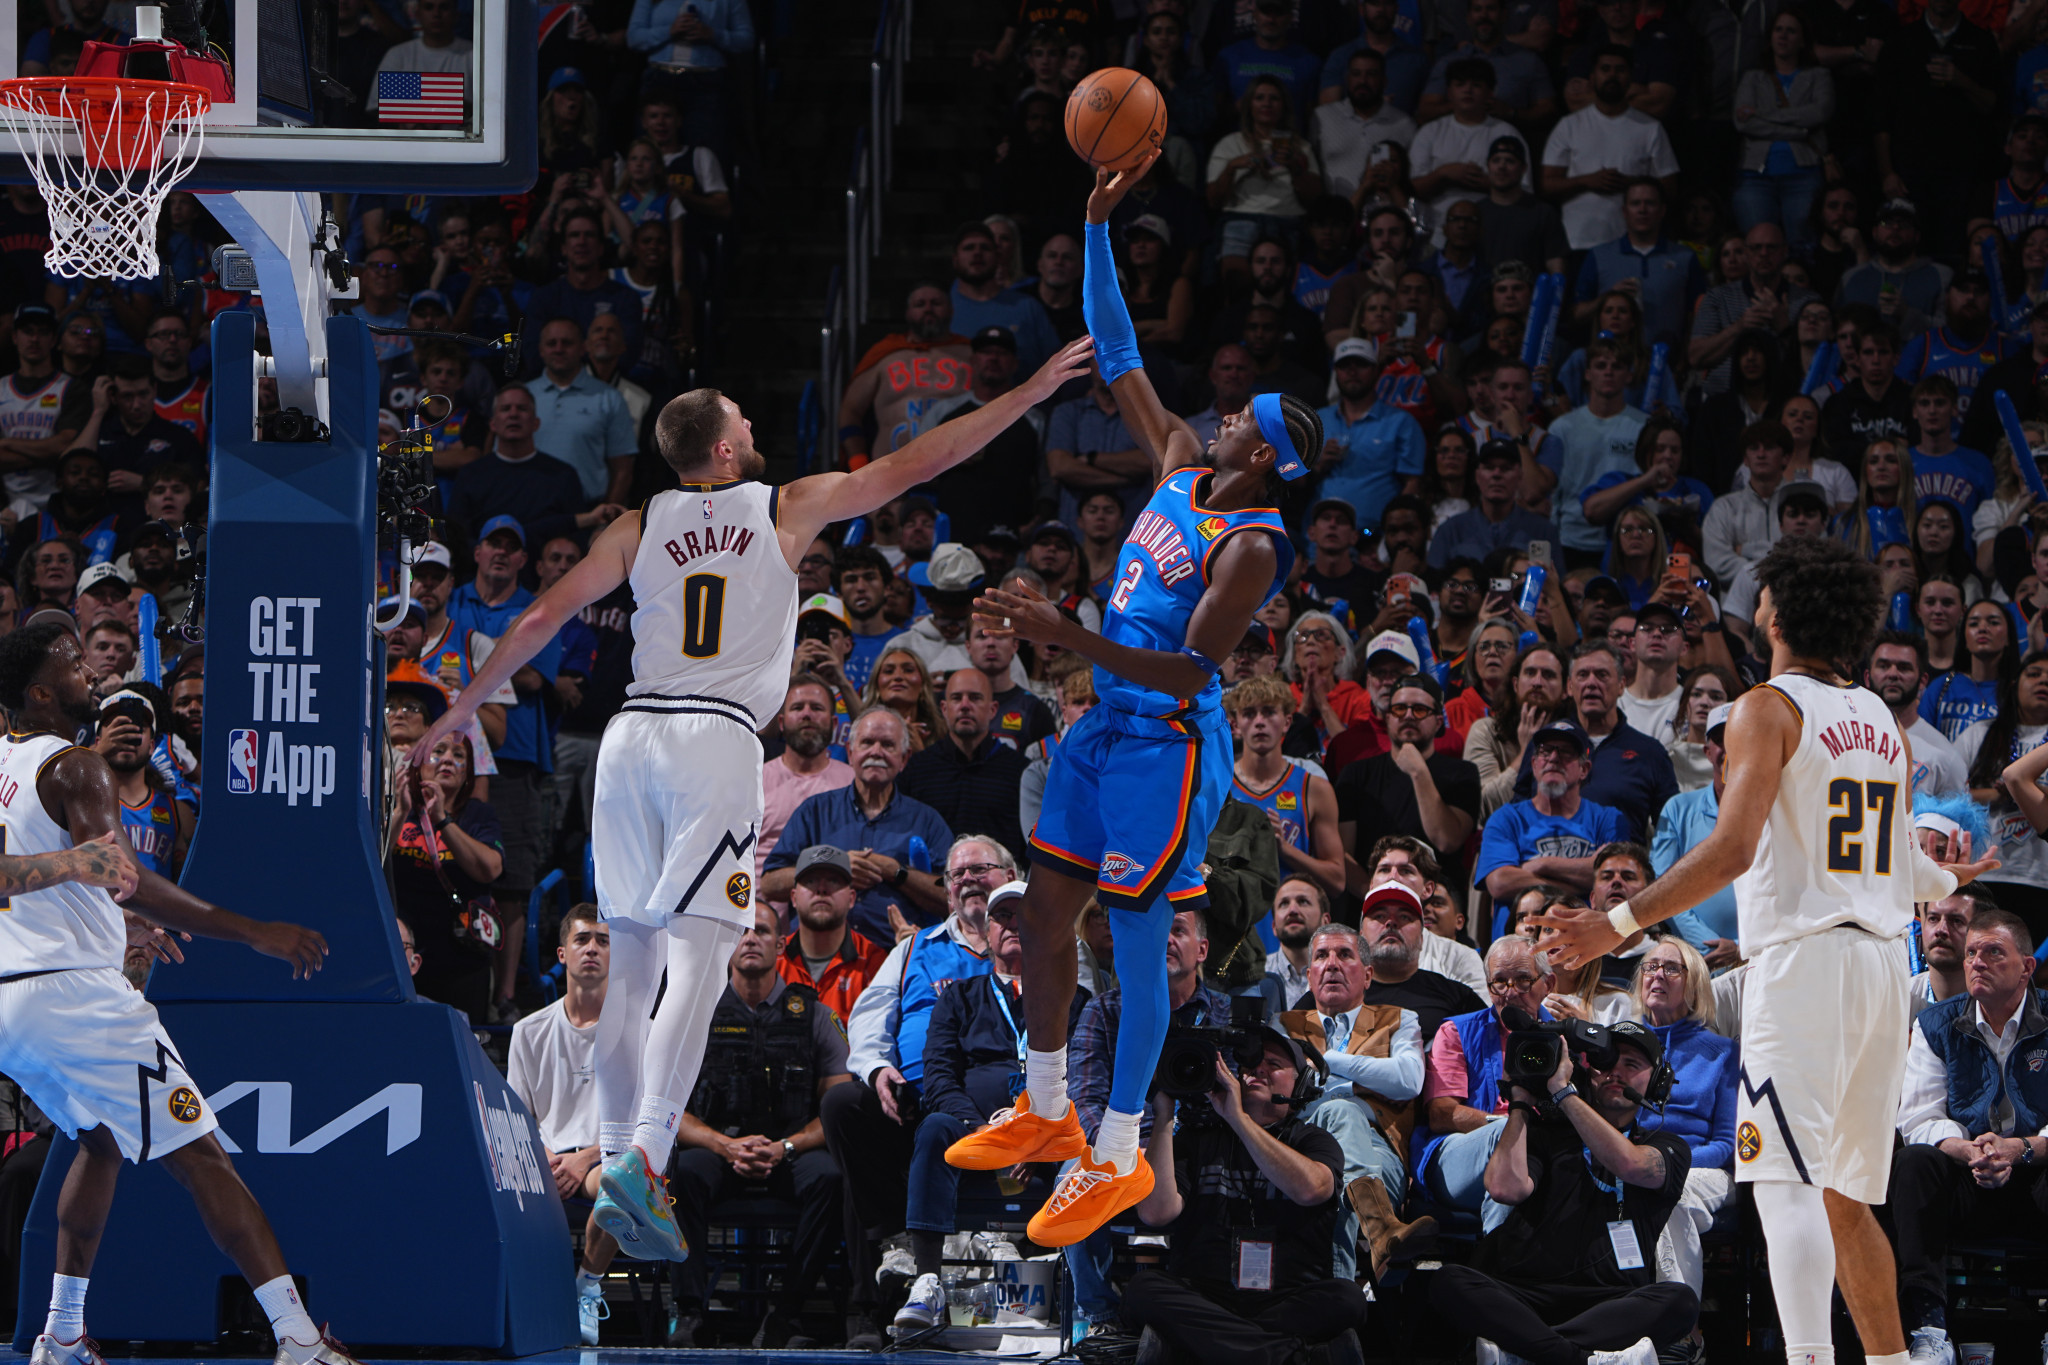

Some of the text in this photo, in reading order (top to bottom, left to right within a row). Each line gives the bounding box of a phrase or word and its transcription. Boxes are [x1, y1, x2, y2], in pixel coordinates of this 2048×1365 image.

[887, 358, 973, 392] BEST
[425, 433, 432, 444] 8
[664, 525, 755, 567] BRAUN
[1125, 510, 1196, 590] THUNDER
[1111, 558, 1144, 613] 2
[249, 596, 321, 657] GET
[682, 572, 728, 660] 0
[249, 663, 320, 723] THE
[231, 731, 336, 807] NBA App
[1819, 720, 1901, 767] MURRAY
[0, 773, 19, 809] LO
[1827, 776, 1899, 876] 27
[1102, 860, 1128, 872] OKC
[997, 1284, 1046, 1306] OMA
